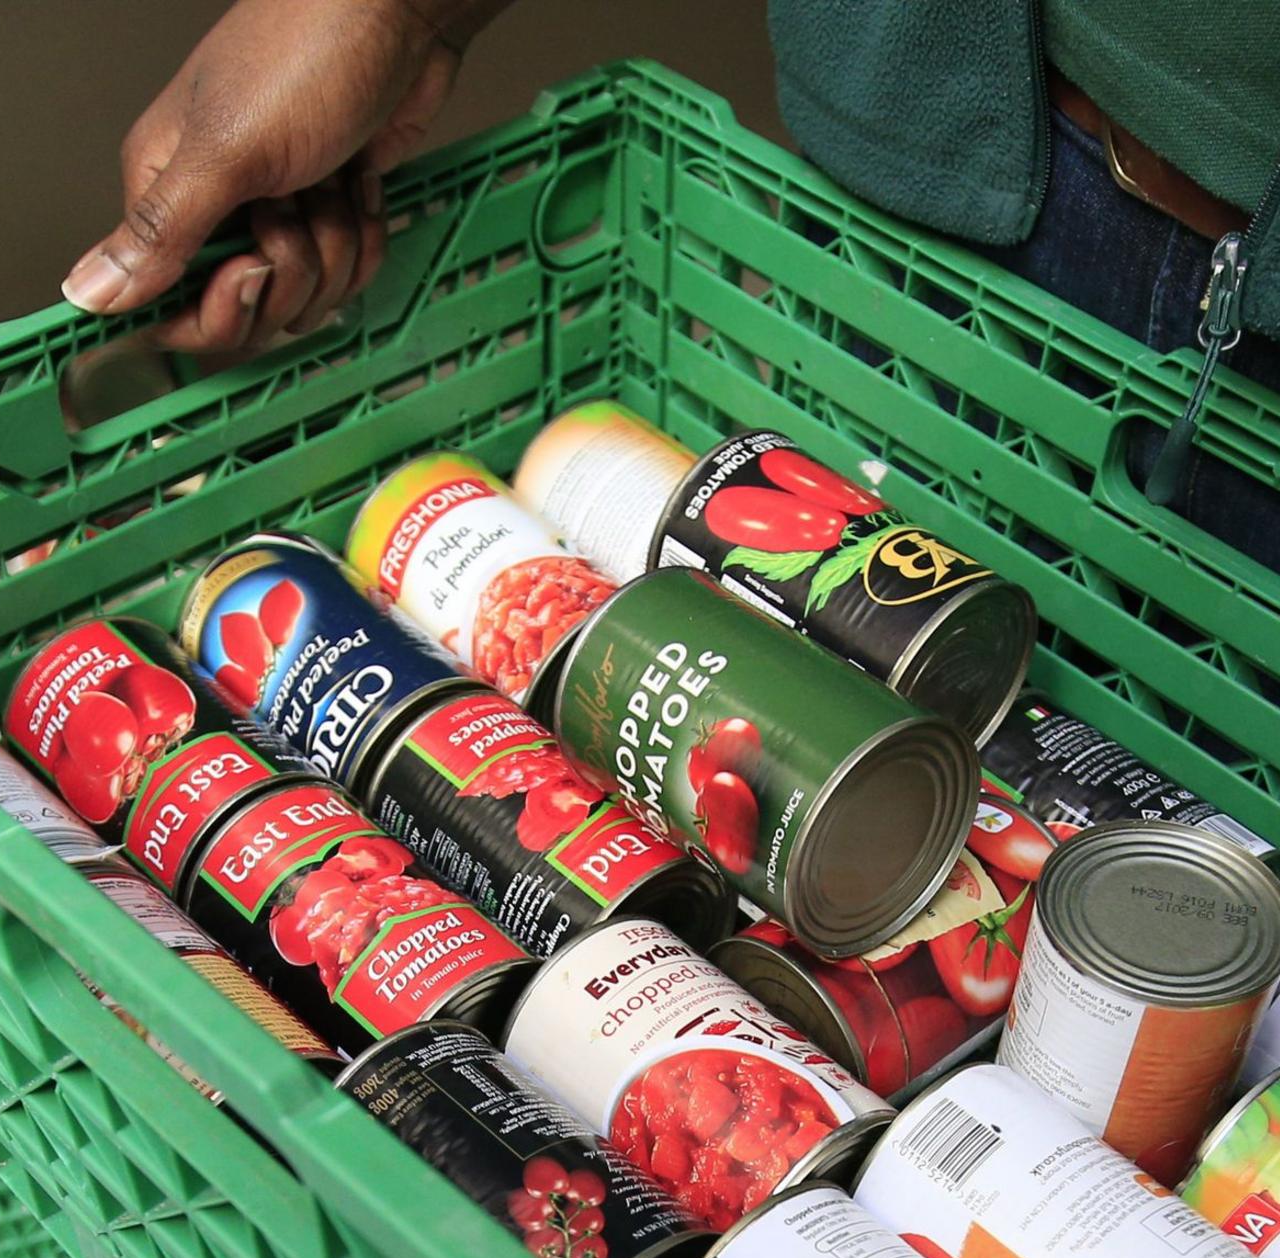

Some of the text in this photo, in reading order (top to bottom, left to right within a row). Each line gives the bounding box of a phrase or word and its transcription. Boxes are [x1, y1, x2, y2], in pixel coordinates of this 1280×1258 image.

[685, 444, 758, 520] TOMATOES
[713, 440, 746, 466] JUICE
[381, 481, 485, 585] FRESHONA
[422, 526, 472, 569] Polpa
[430, 524, 513, 610] di pomodori
[29, 645, 110, 736] Tomatoes
[301, 628, 370, 704] Peeled
[39, 653, 133, 758] Peeled Plum
[144, 752, 254, 872] East End
[1122, 775, 1151, 798] 400g
[219, 821, 289, 884] East
[281, 796, 353, 827] End
[581, 834, 651, 884] End
[768, 827, 789, 877] TOMATO
[780, 787, 805, 830] JUICE
[365, 911, 464, 982] Chopped
[374, 927, 486, 1005] Tomatoes
[410, 948, 485, 1001] in Tomato Juice
[584, 944, 692, 1001] Everyday
[600, 965, 697, 1038] chopped
[630, 1039, 645, 1056] No
[644, 1006, 685, 1043] artificial
[654, 984, 701, 1015] Produced
[352, 1069, 386, 1102] 260g
[367, 1086, 401, 1118] 400g
[783, 1206, 812, 1226] Chopped
